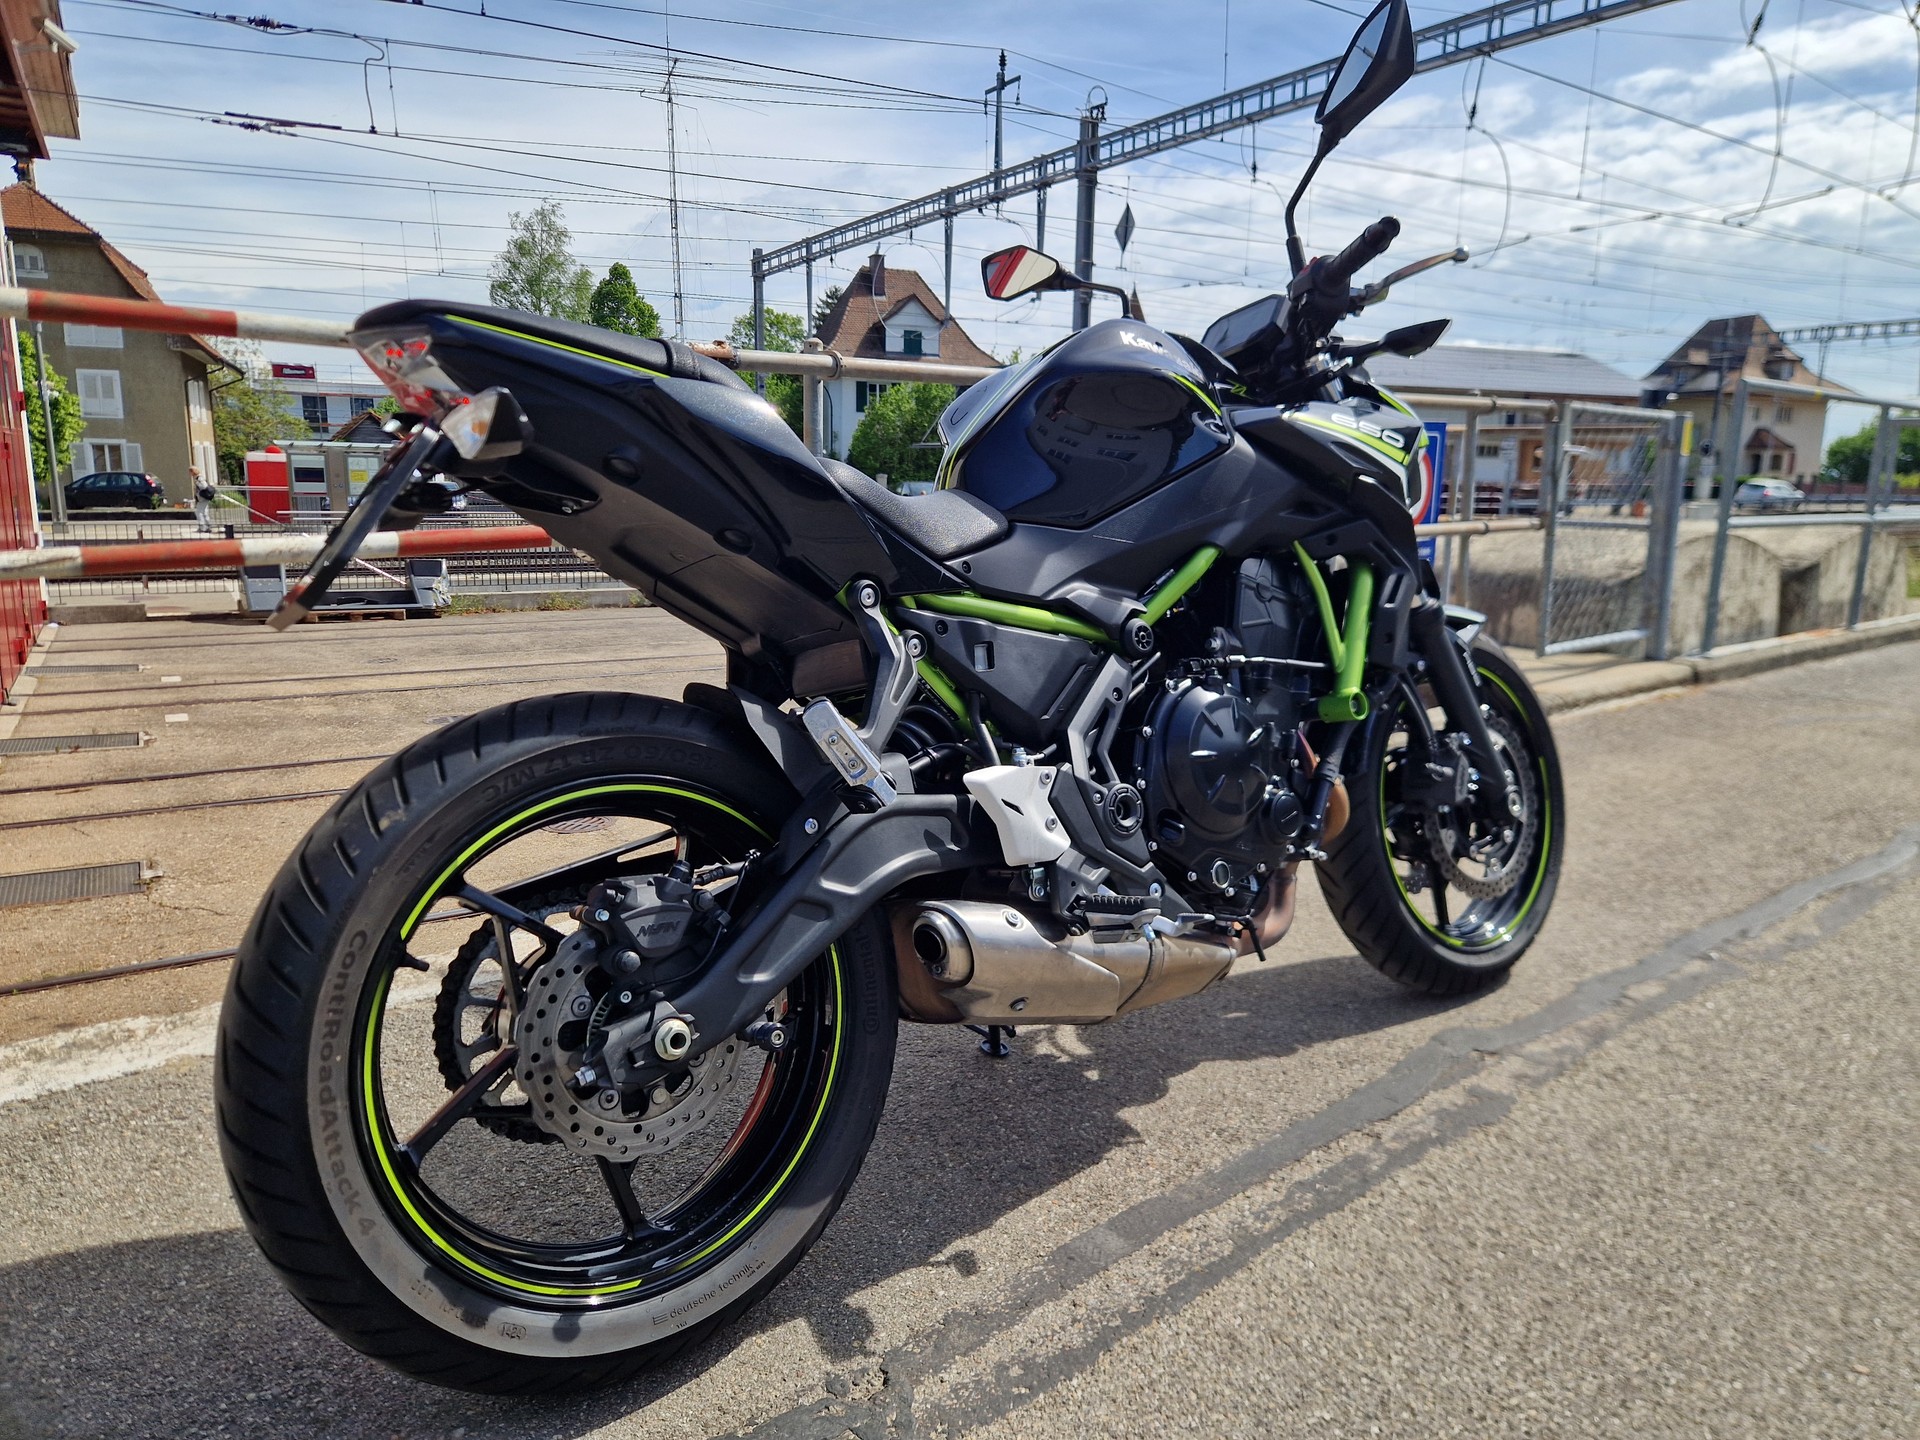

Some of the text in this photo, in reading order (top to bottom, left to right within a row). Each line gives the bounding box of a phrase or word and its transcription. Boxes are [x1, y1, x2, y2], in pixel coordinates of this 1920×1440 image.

[1331, 413, 1405, 448] 650
[545, 755, 571, 773] 17
[582, 749, 614, 766] ZR
[479, 765, 537, 802] M/C
[318, 930, 377, 1237] ContiRoadAttack 4
[669, 1288, 717, 1319] deutsche
[718, 1263, 753, 1292] technik
